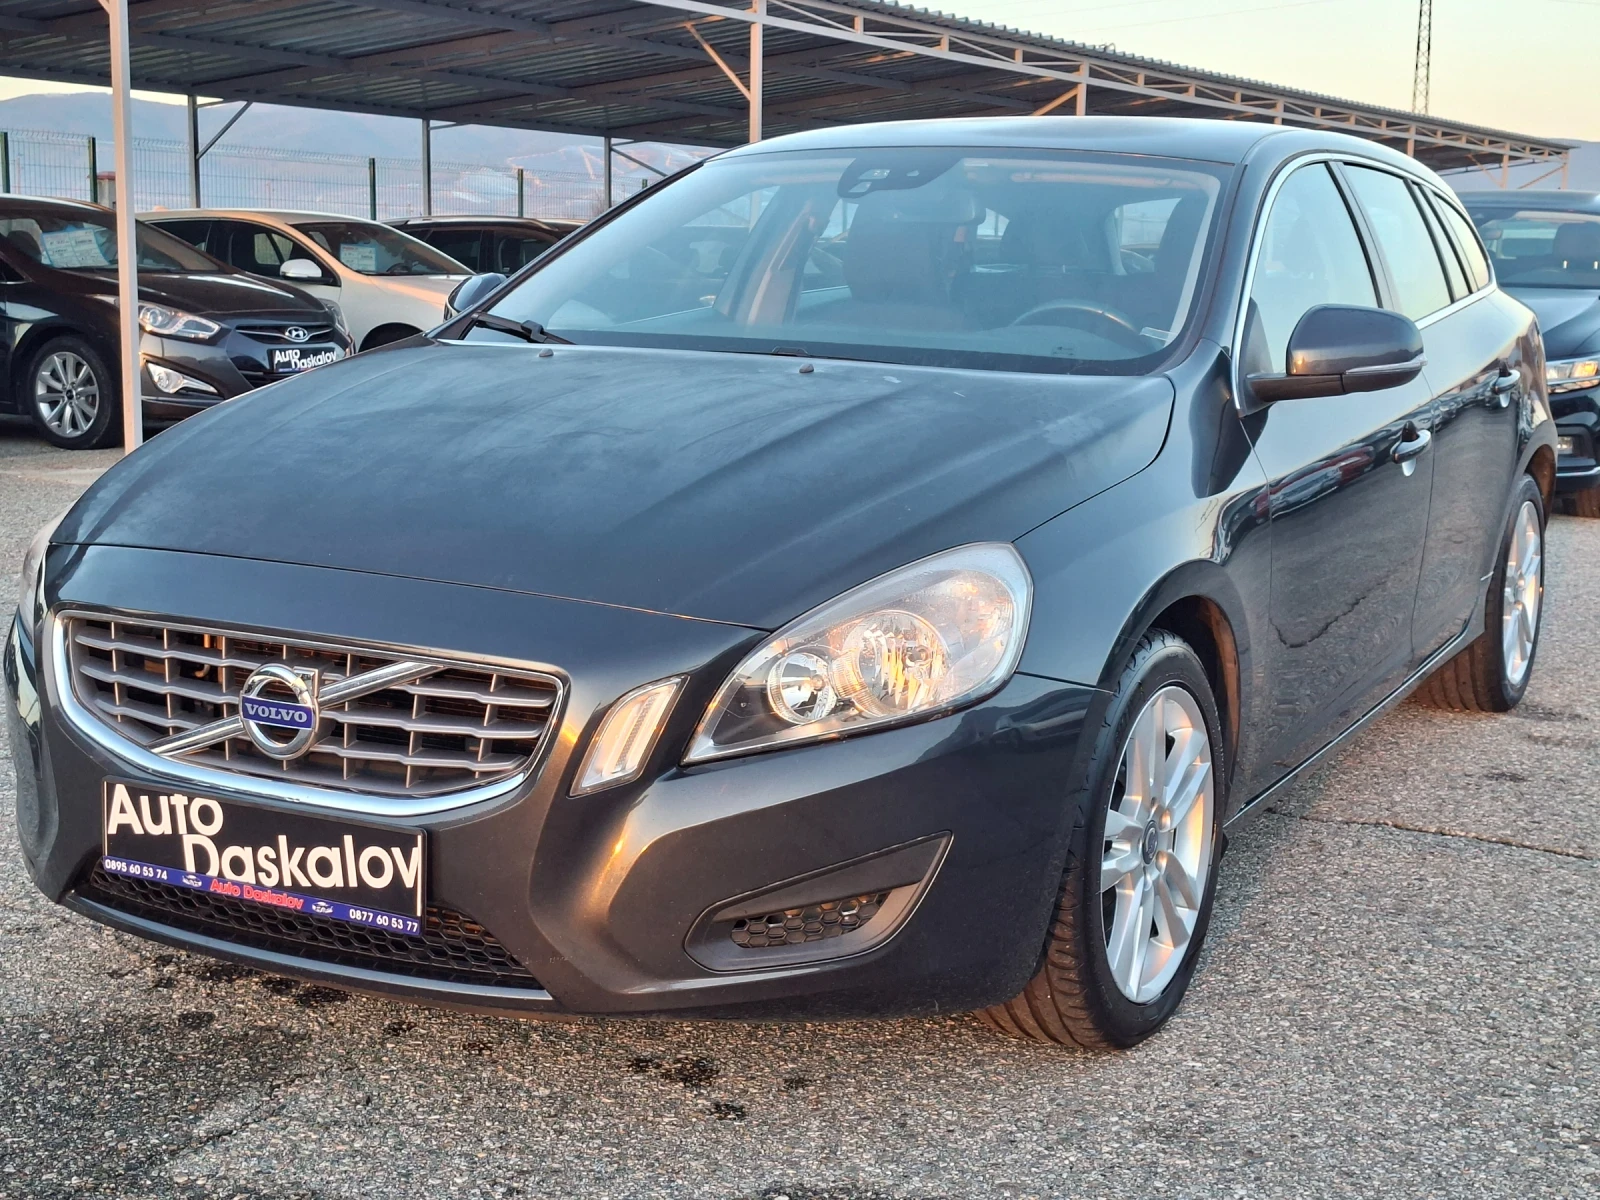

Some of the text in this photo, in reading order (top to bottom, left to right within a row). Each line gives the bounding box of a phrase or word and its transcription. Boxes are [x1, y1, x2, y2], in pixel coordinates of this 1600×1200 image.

[275, 349, 300, 362] Auto
[290, 350, 336, 369] Daskalov
[244, 703, 307, 722] VOLVO
[107, 783, 224, 836] Auto
[105, 859, 168, 880] 0895 60 53 74
[182, 834, 418, 888] Daskalov
[210, 878, 304, 910] Auto Daskalov
[349, 908, 418, 932] 0877 60 53 77
